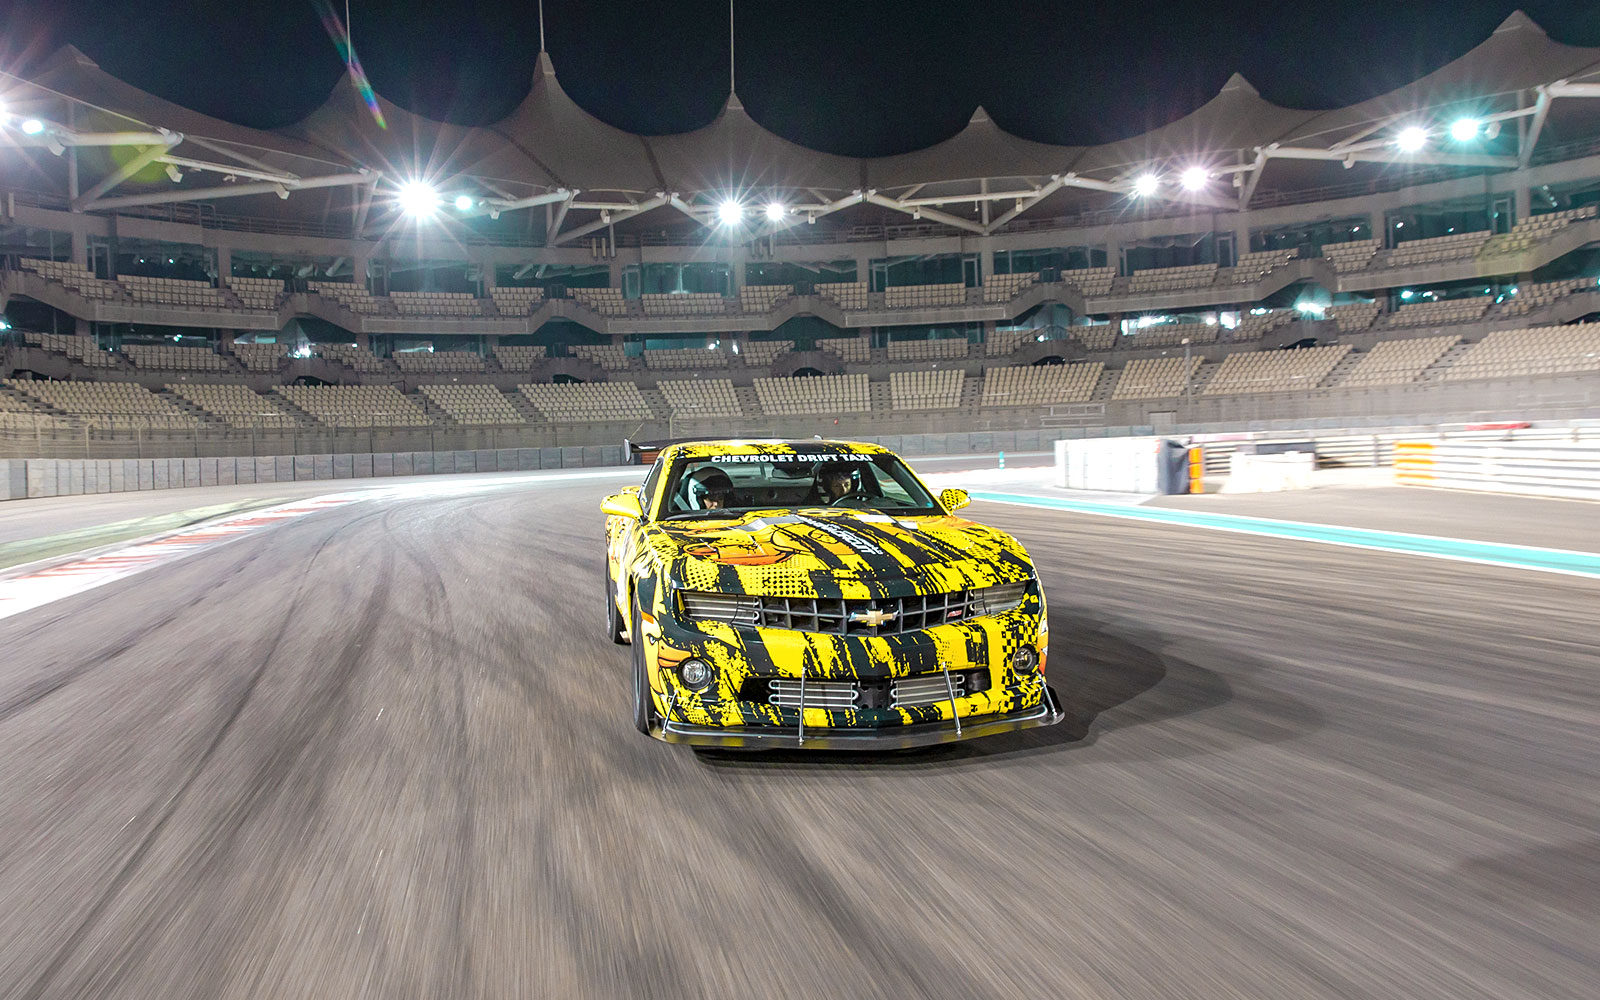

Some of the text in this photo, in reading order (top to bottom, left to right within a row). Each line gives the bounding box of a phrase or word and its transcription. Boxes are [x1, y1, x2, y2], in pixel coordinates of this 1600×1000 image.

[711, 454, 874, 463] CHEVROLET DRIFT TAXI
